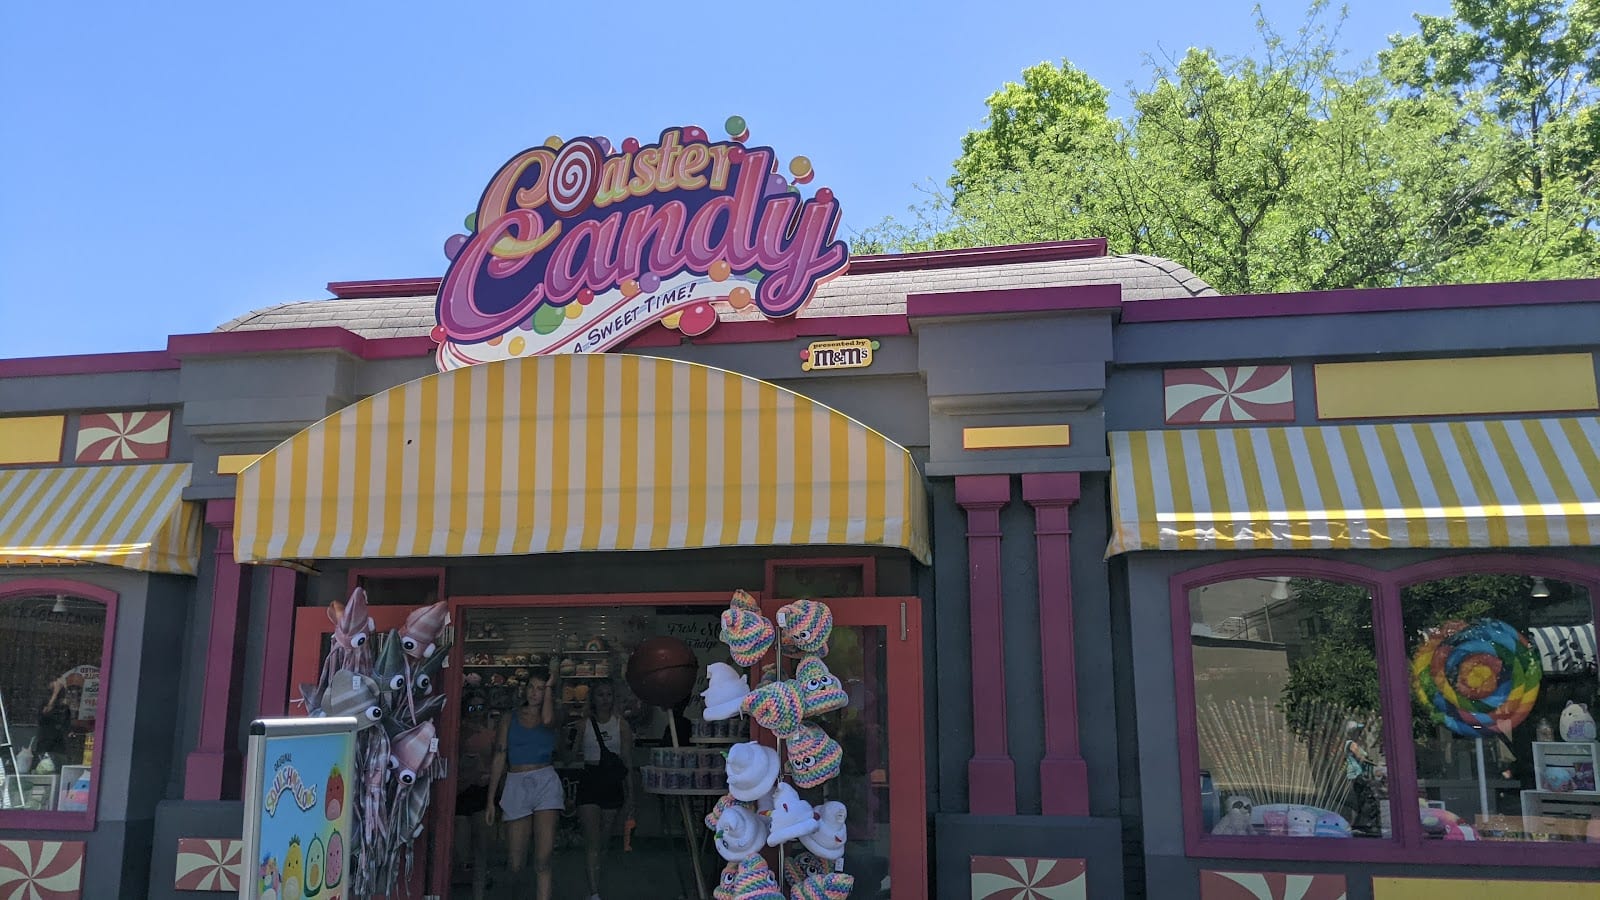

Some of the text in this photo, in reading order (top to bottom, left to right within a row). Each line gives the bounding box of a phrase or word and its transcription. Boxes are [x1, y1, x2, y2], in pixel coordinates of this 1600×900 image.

[478, 127, 735, 258] Coaster
[438, 148, 844, 341] Candy
[574, 282, 697, 353] A SWEET TIME!
[813, 340, 855, 349] presented
